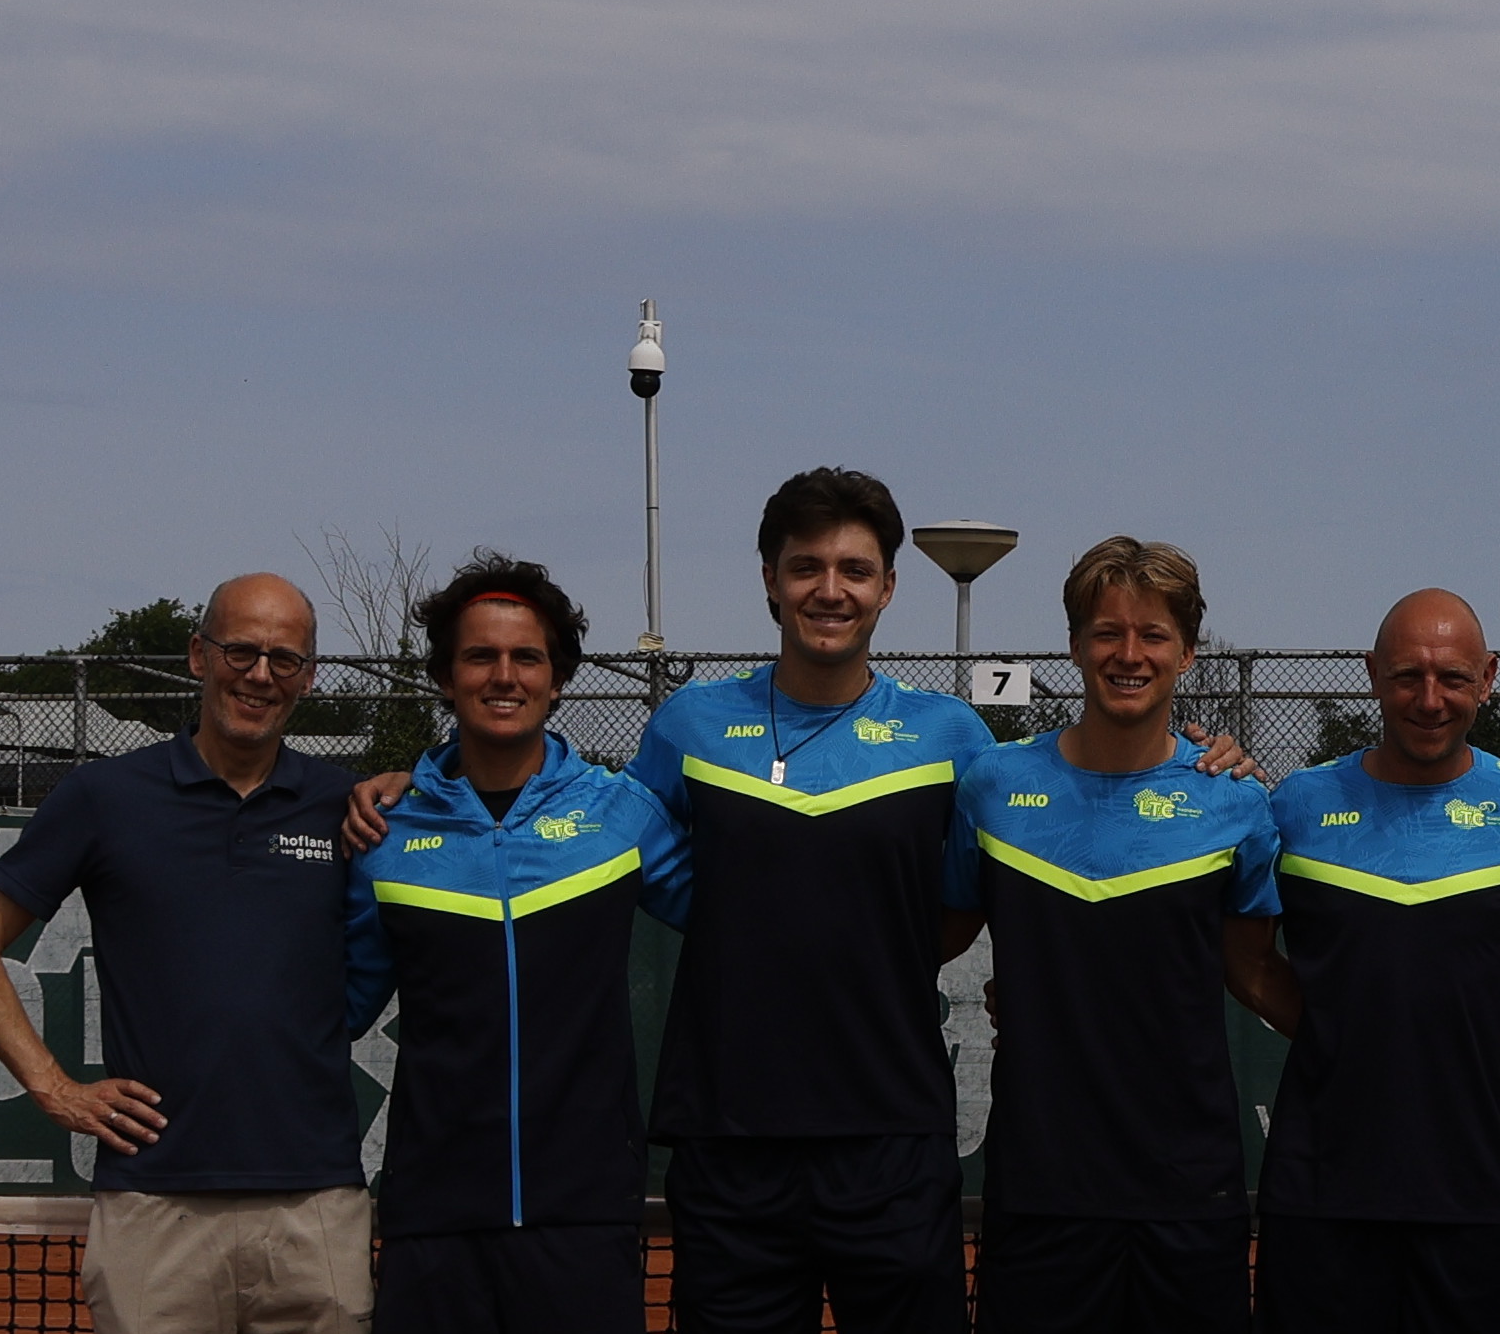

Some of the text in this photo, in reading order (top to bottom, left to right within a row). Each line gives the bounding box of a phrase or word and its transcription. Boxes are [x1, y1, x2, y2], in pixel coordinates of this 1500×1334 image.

[993, 672, 1011, 696] 7
[724, 725, 766, 739] JAKO
[857, 727, 894, 742] LTC
[1007, 793, 1050, 808] JAKO
[1138, 800, 1176, 818] LTC
[1320, 811, 1361, 827] JAKO
[1451, 810, 1486, 827] LTC
[540, 822, 579, 839] LTC
[279, 834, 333, 850] hofland
[403, 835, 444, 853] JAKO
[295, 848, 334, 861] geest
